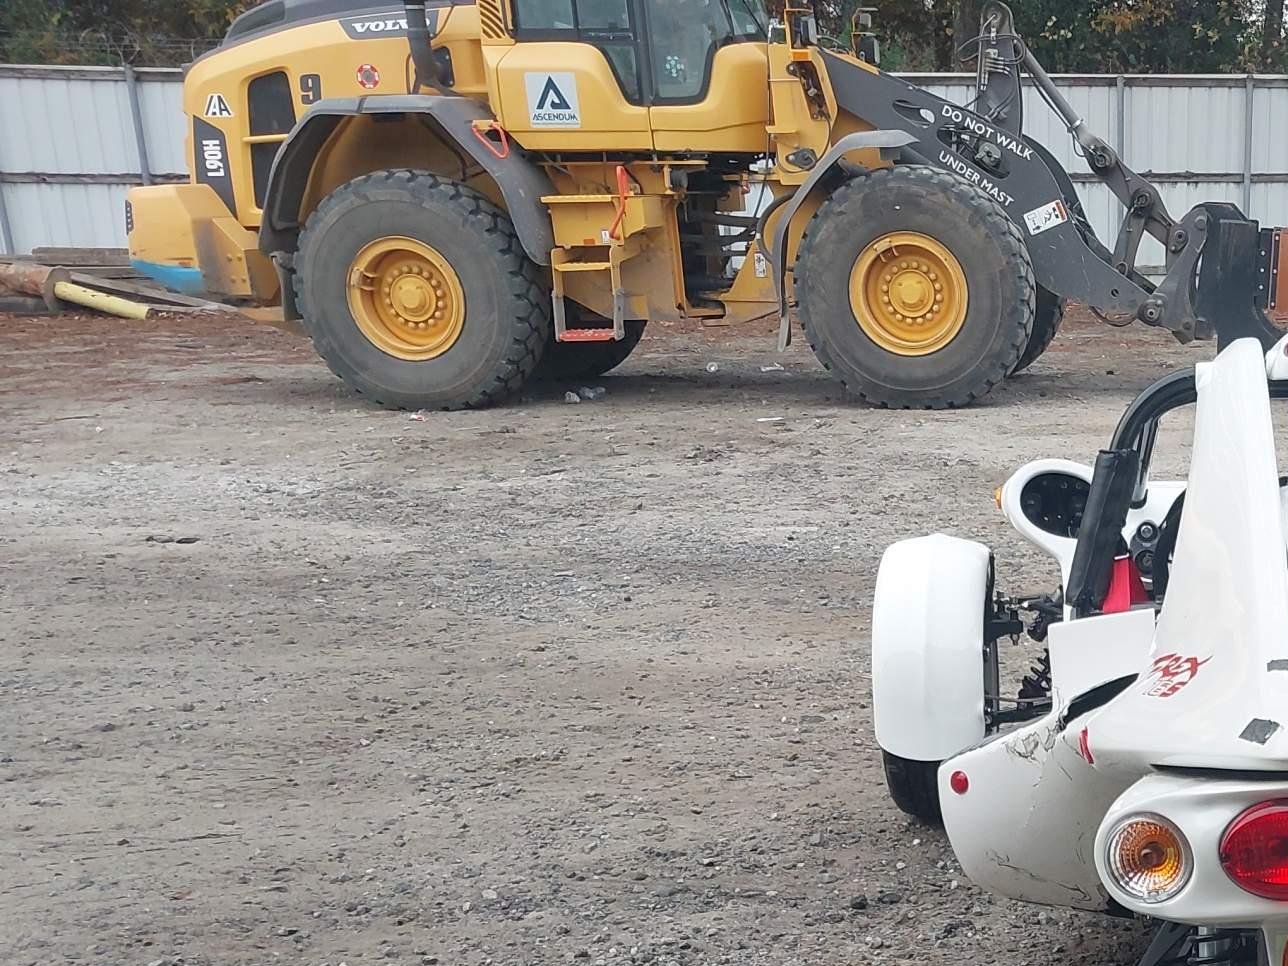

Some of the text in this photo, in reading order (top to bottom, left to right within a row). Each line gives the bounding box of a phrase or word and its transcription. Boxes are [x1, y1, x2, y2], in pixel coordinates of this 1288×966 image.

[299, 74, 322, 105] 9
[532, 113, 578, 121] ASCENDUM
[942, 105, 1034, 161] DO NOT WALK
[202, 140, 225, 177] L90H
[939, 150, 1015, 207] UNDER MAST
